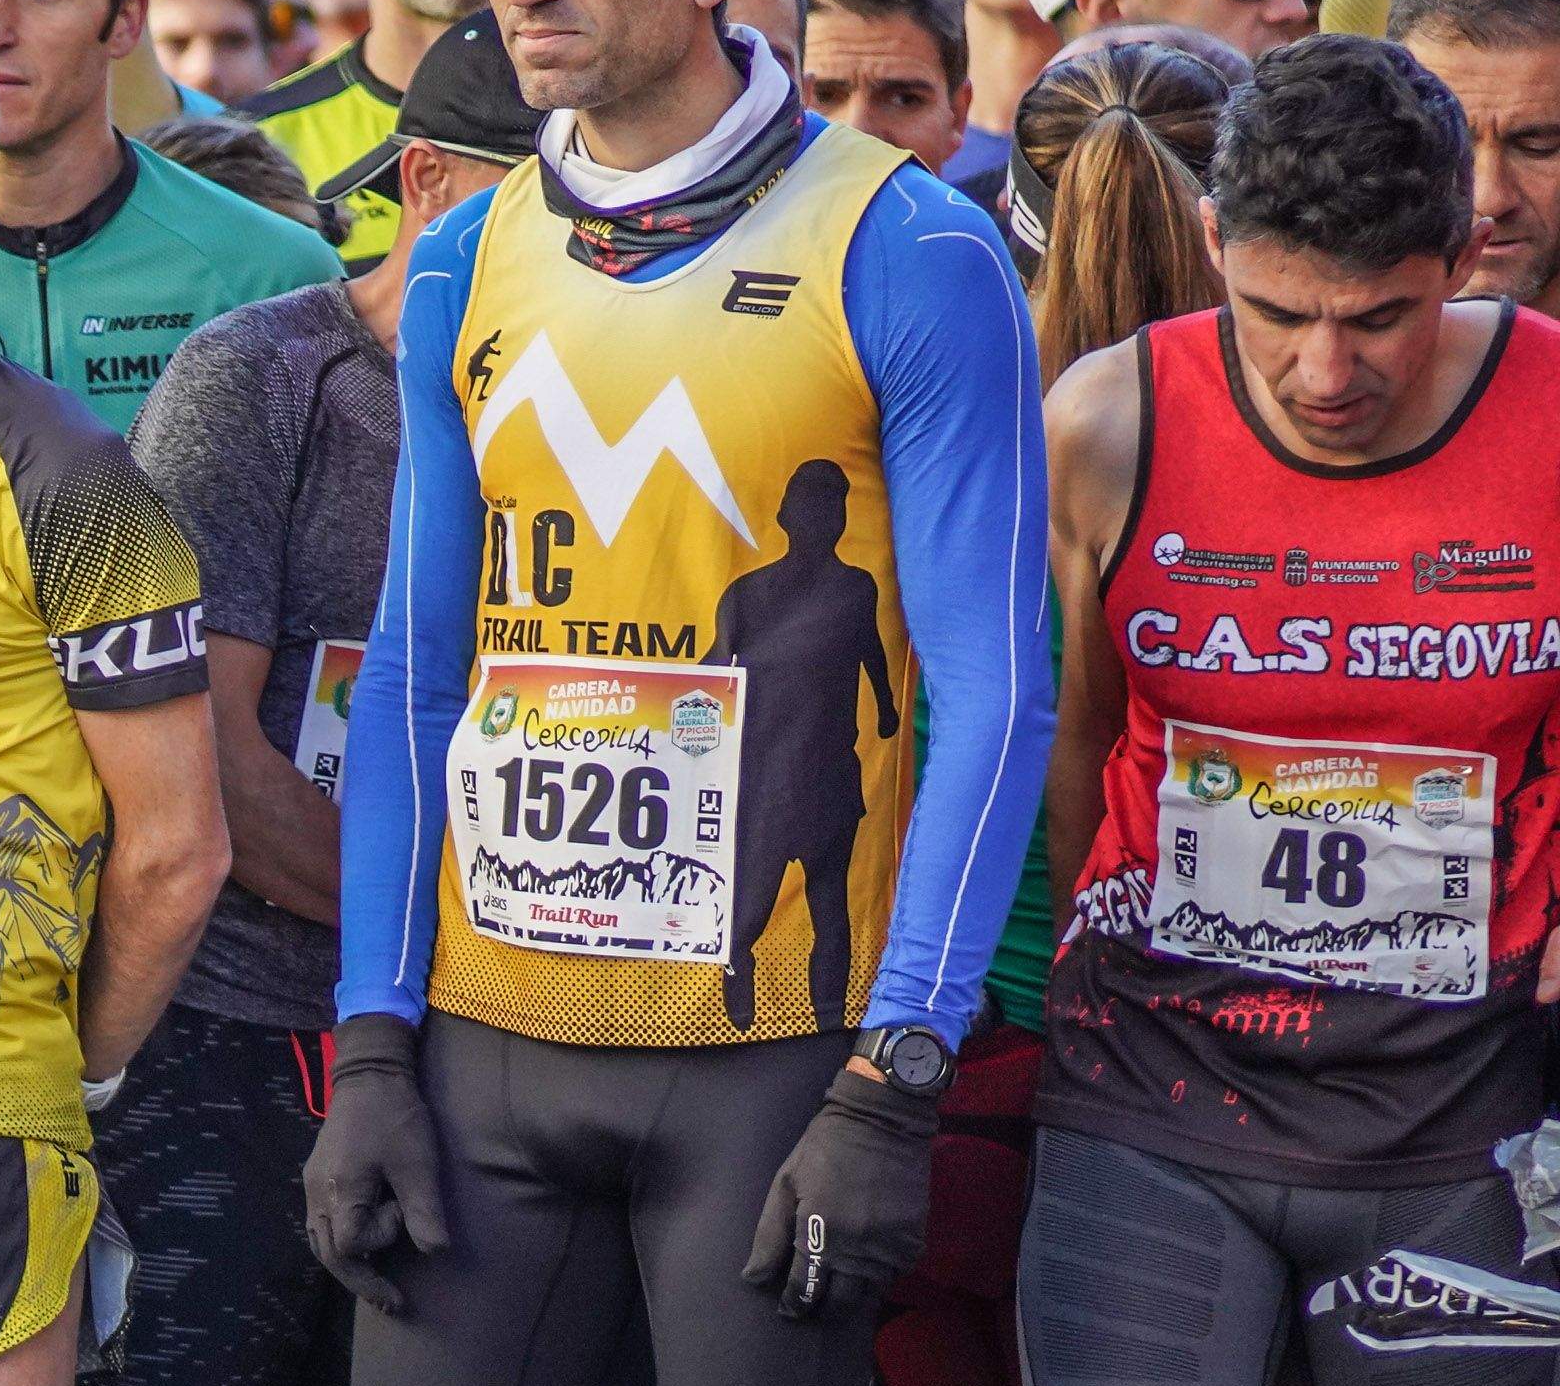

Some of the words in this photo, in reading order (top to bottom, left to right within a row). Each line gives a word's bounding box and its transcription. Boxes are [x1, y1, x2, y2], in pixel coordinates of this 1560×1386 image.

[484, 508, 575, 608] DLC
[1311, 560, 1401, 571] AYUNTAMIENTO
[1439, 543, 1533, 568] Magullo
[1168, 572, 1258, 589] www.imdsg.es
[1311, 574, 1327, 583] DE
[1329, 574, 1380, 584] SEGOVIA
[482, 617, 550, 654] TRAIL
[561, 620, 697, 659] TEAM
[548, 679, 622, 700] CARRERA
[624, 684, 637, 694] DE
[543, 695, 637, 719] NAVIDAD
[675, 727, 685, 740] 7
[685, 726, 717, 735] PICOS
[681, 734, 717, 743] Cercedilla
[1275, 756, 1365, 777] CARRERA
[1274, 770, 1380, 795] NAVIDAD
[494, 756, 671, 851] 1526
[1261, 827, 1368, 909] 48
[490, 895, 508, 911] asics
[527, 903, 572, 925] Trail
[572, 910, 620, 929] Run
